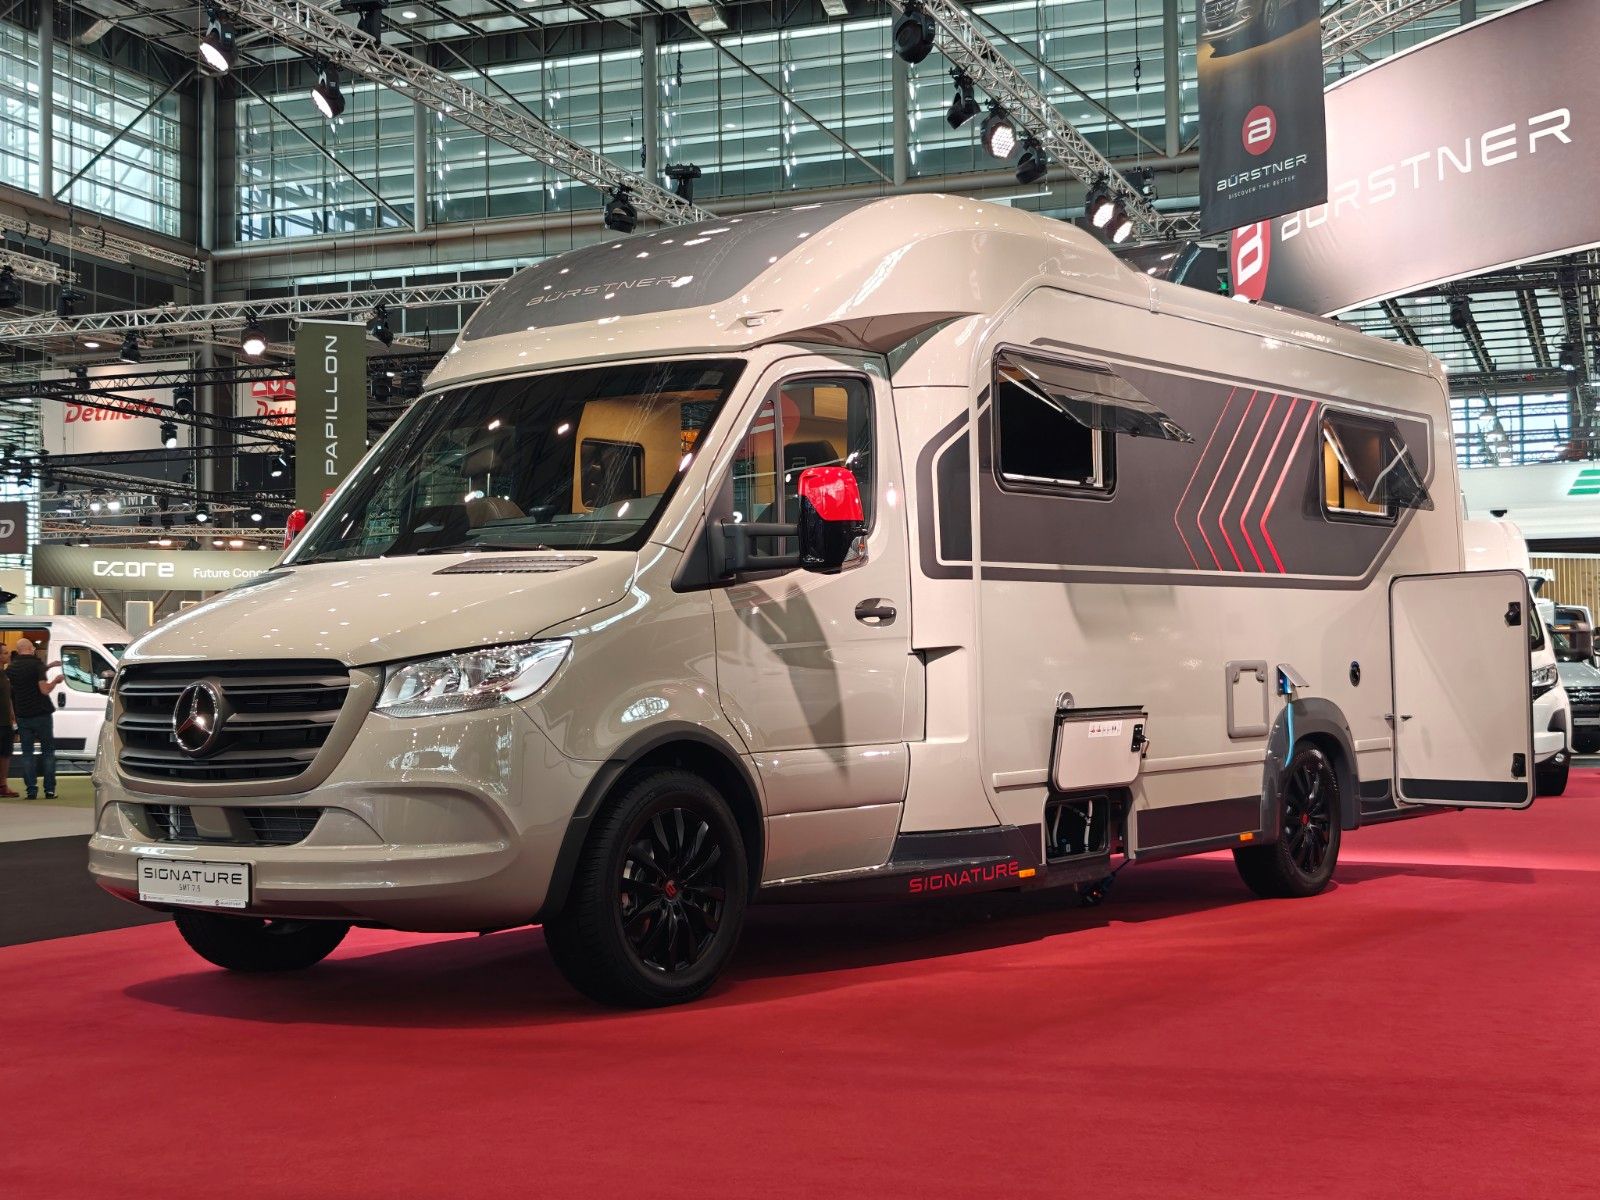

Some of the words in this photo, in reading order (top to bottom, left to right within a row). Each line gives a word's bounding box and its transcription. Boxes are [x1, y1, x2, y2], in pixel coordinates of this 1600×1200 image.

[1216, 153, 1307, 192] BÜRSTNER
[526, 275, 677, 307] BÜRSTNER
[325, 335, 338, 476] PAPILLON
[193, 568, 231, 578] Future
[143, 867, 242, 885] SIGNATURE
[908, 859, 1019, 893] SIGNATURE
